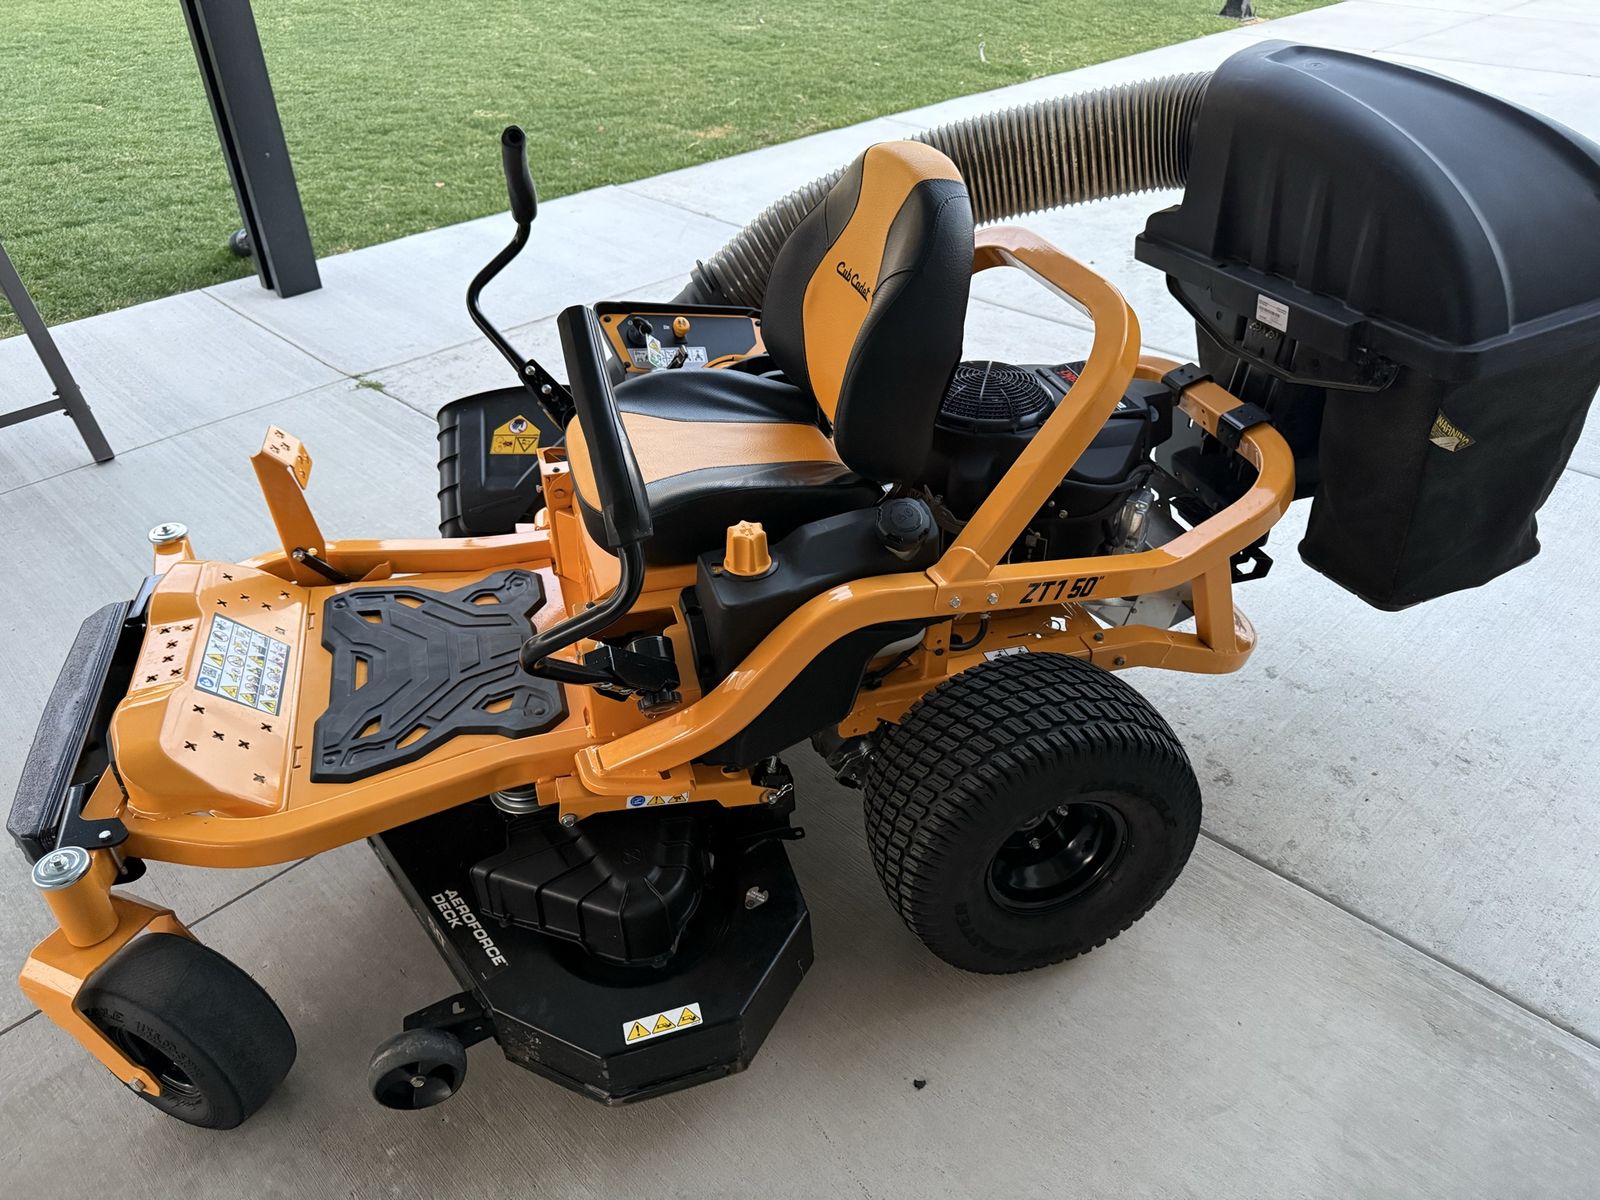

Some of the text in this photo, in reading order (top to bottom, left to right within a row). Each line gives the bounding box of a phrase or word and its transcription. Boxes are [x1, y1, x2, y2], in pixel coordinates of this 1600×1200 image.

[836, 261, 871, 302] Cub Cadet
[1019, 580, 1068, 604] ZT1
[431, 893, 464, 929] DECK
[444, 889, 509, 967] AEROFORCE
